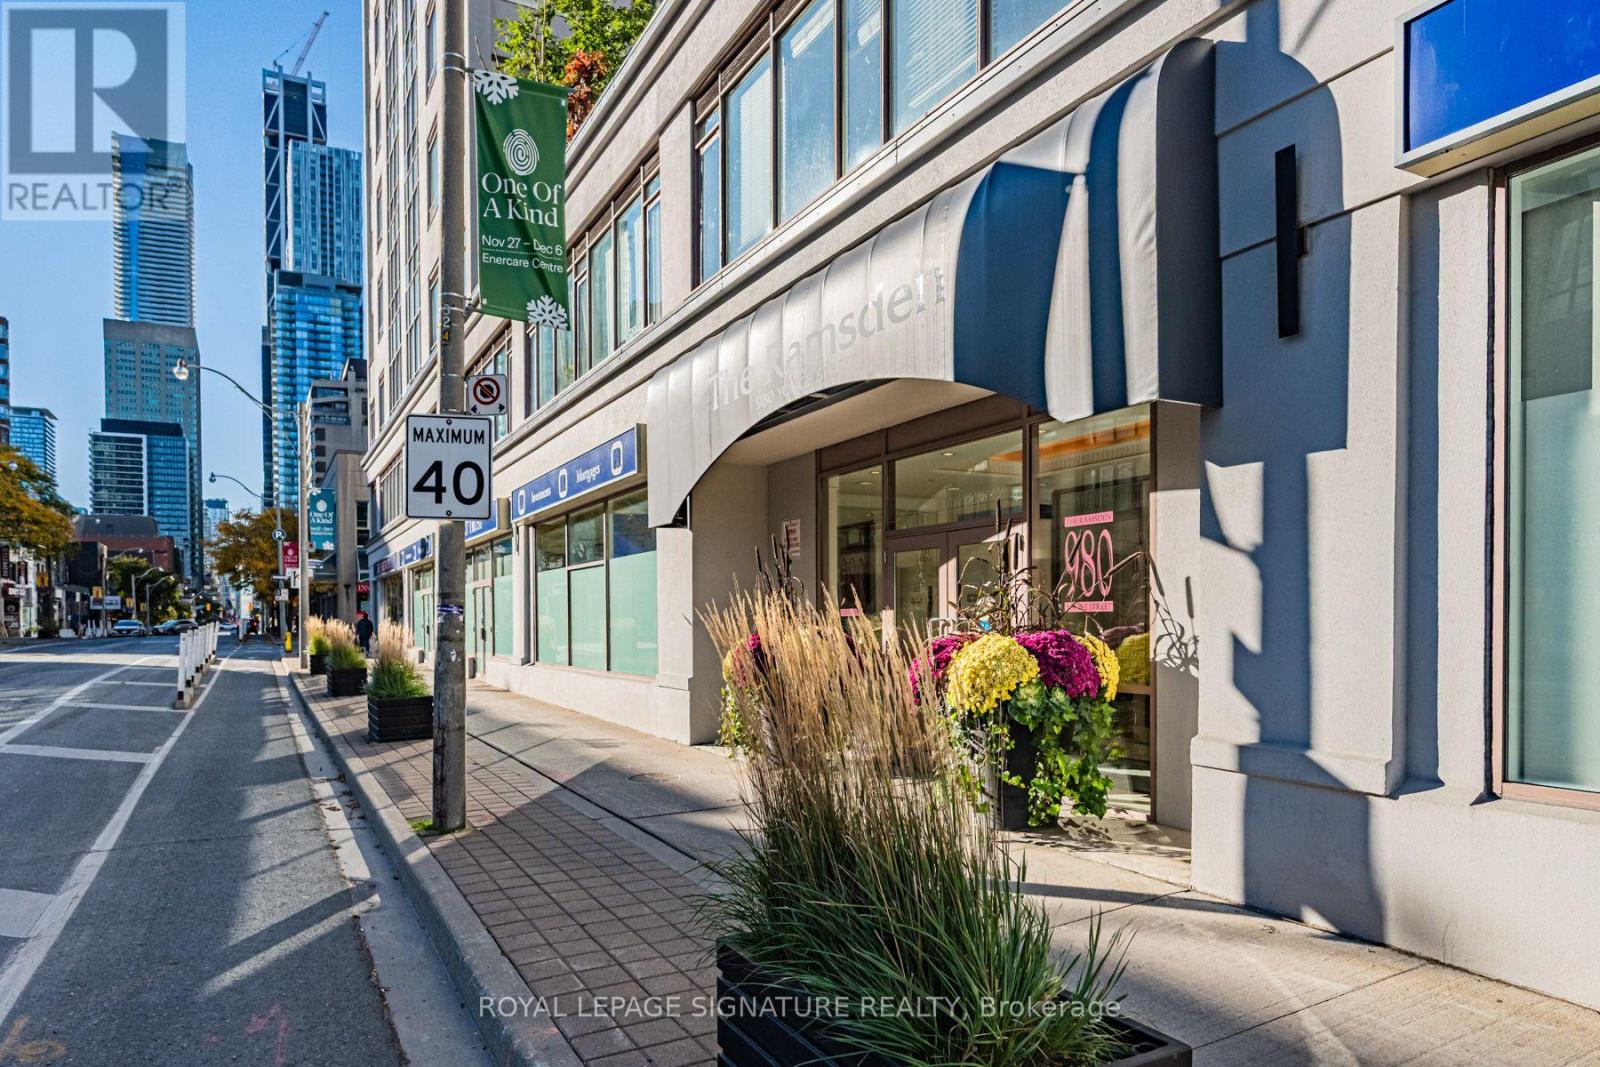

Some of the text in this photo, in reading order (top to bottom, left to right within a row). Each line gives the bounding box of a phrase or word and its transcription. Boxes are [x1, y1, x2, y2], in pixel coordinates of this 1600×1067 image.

[482, 172, 562, 205] One Of
[483, 197, 559, 228] A Kind
[482, 234, 505, 247] Nov
[507, 236, 521, 249] 27
[533, 238, 553, 255] Dec
[555, 244, 563, 256] 6
[482, 252, 563, 273] Enercare Centre
[412, 426, 485, 445] MAXIMUM
[412, 460, 485, 506] 40
[1065, 529, 1113, 597] 980
